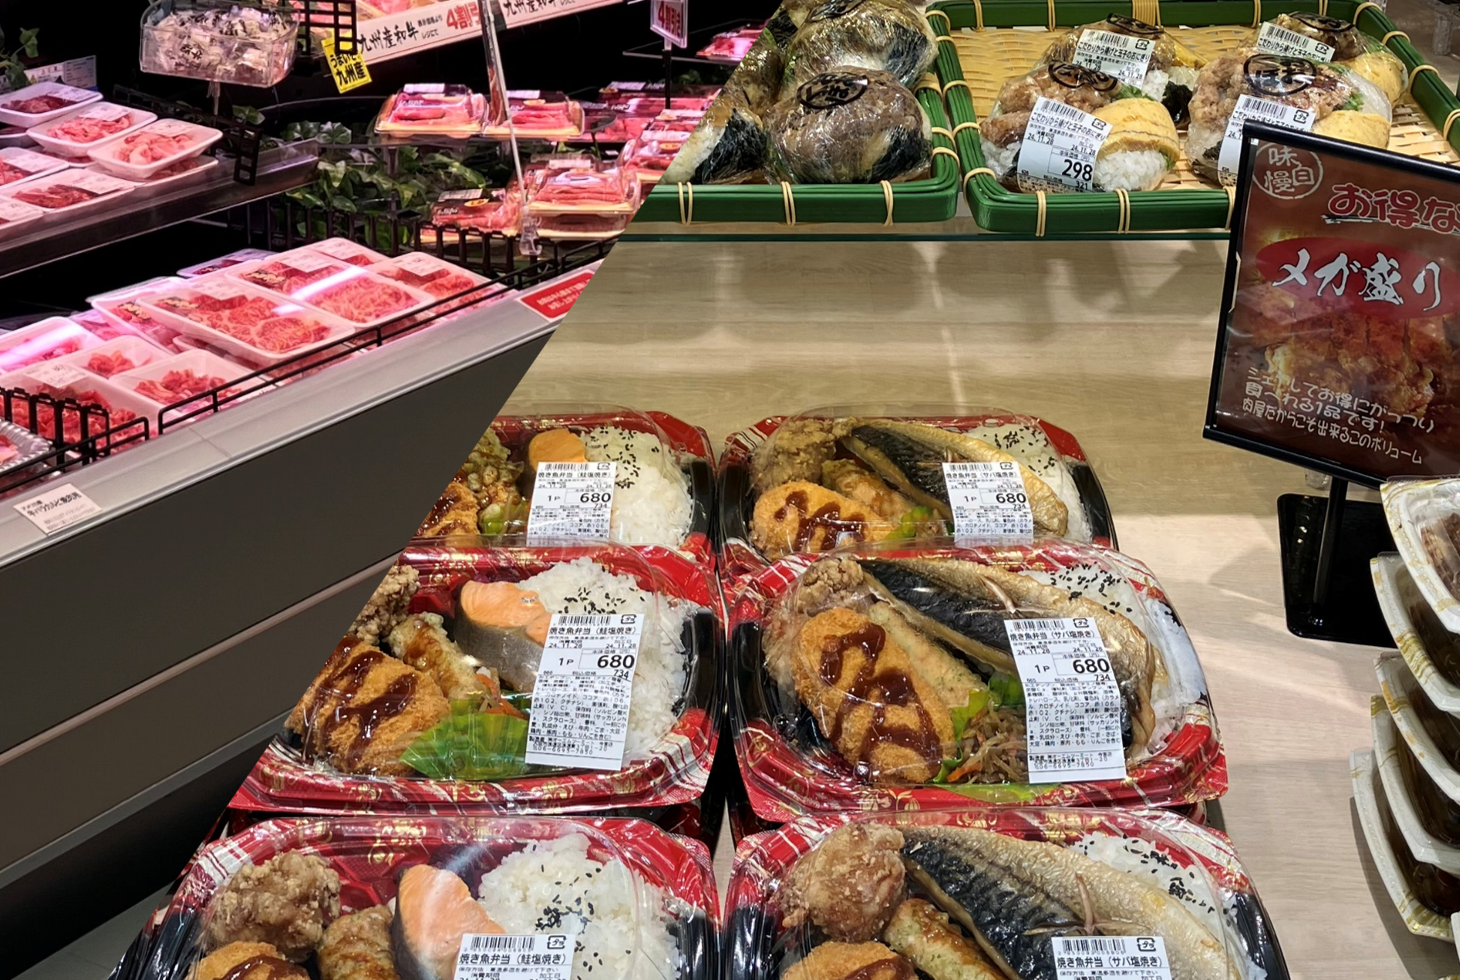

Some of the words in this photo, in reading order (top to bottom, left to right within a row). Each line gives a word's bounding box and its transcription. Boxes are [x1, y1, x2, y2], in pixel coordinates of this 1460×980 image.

[357, 24, 420, 54] 九州産和牛
[1077, 40, 1150, 63] こだわりから揚げと玉子のおにぎり
[336, 62, 367, 86] 九州産
[1030, 111, 1107, 141] こだわりから揚げと玉子のおにぎり
[1062, 159, 1094, 182] 298
[1075, 180, 1089, 190] 321
[1271, 248, 1442, 312] メガ盛り
[1242, 396, 1423, 466] 肉屋だからこそ出来るこのボリューム
[580, 492, 612, 504] 680
[996, 493, 1026, 504] 680
[549, 625, 638, 636] 焼き魚弁当（鮭塩焼き）
[1010, 630, 1096, 641] 焼き魚弁当（サバ塩焼き）
[597, 654, 635, 669] 680
[1072, 658, 1110, 674] 680
[613, 669, 629, 679] 734
[1094, 674, 1111, 682] 734
[459, 953, 567, 965] 焼き魚弁当（鮭塩焼き）
[1057, 956, 1162, 968] 焼き魚弁当（サバ塩焼き）
